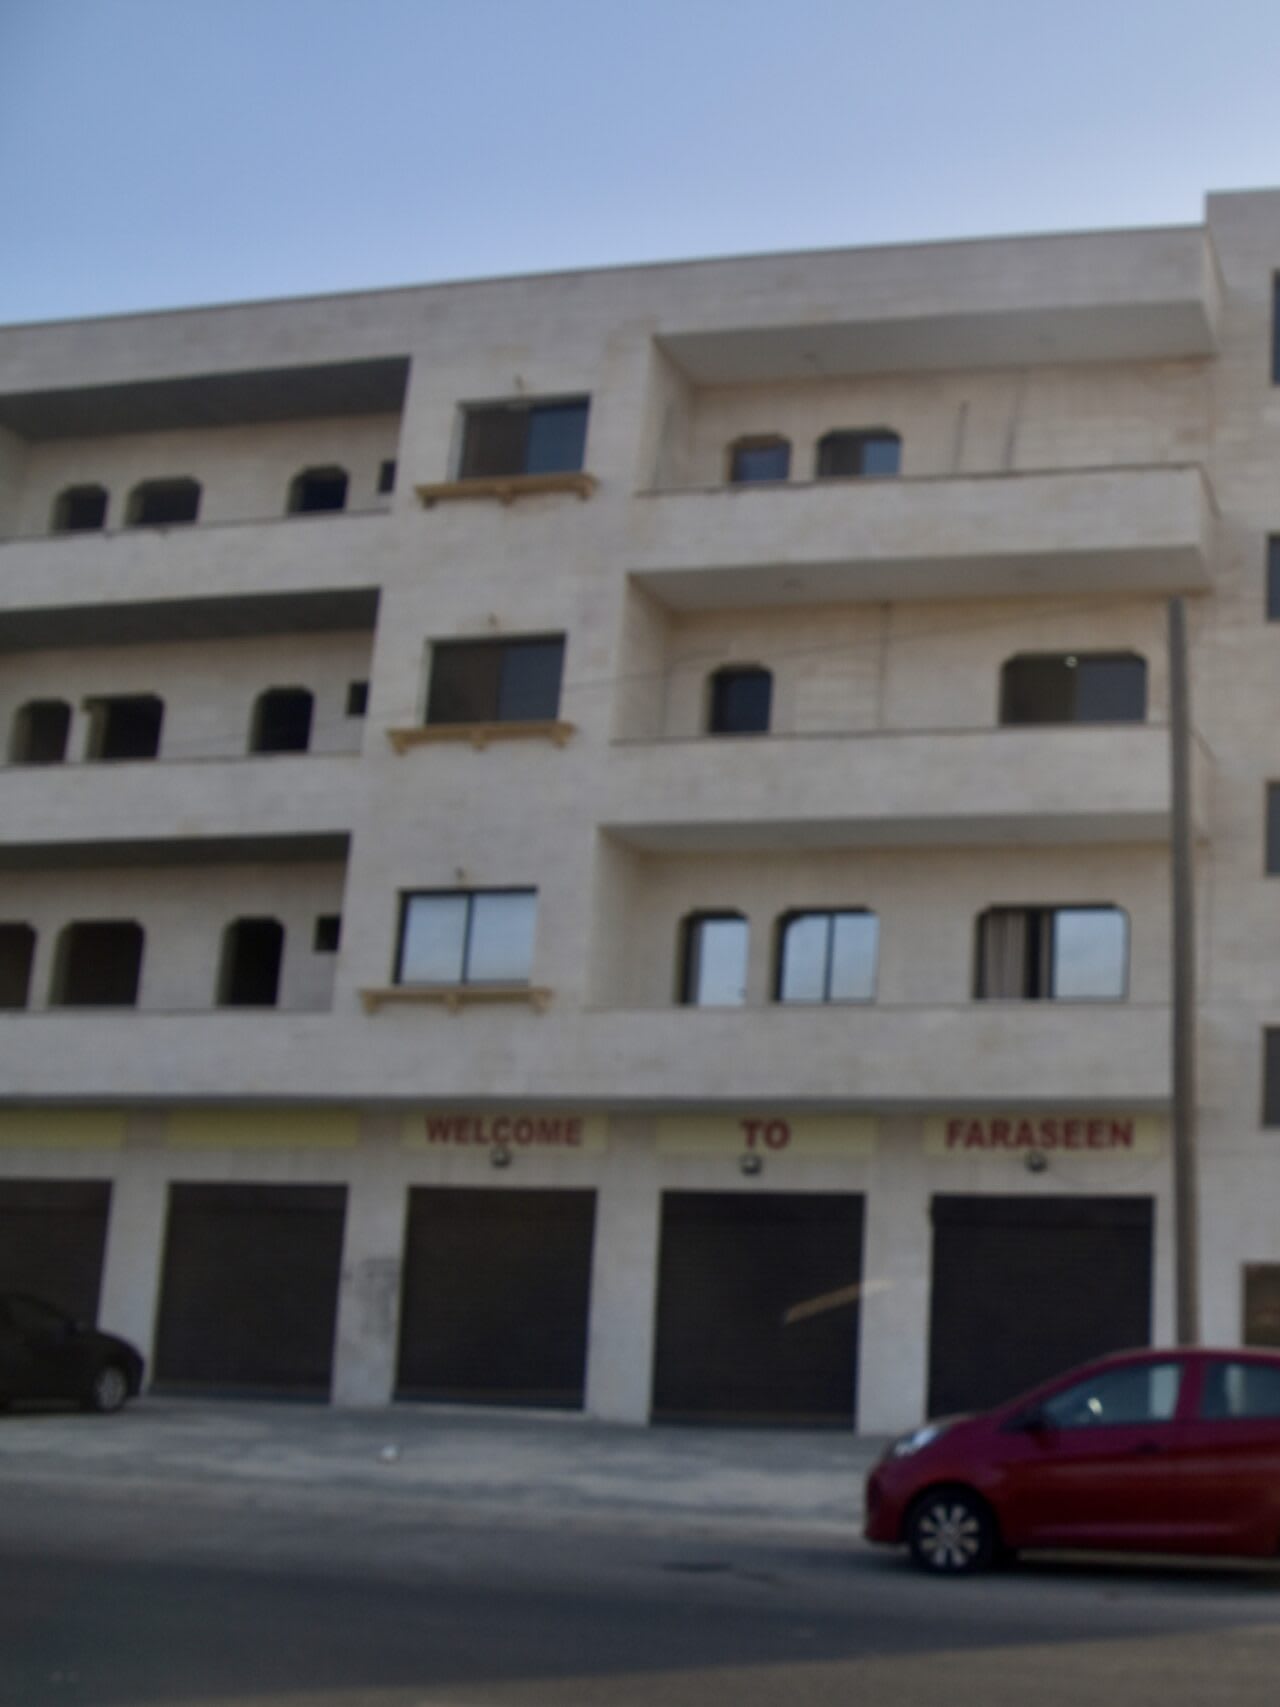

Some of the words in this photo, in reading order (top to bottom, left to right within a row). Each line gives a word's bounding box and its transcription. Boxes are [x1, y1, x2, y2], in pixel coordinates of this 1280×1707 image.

[426, 1115, 583, 1147] WELCOME
[741, 1120, 791, 1150] TO
[946, 1120, 1134, 1150] FARASEEN
